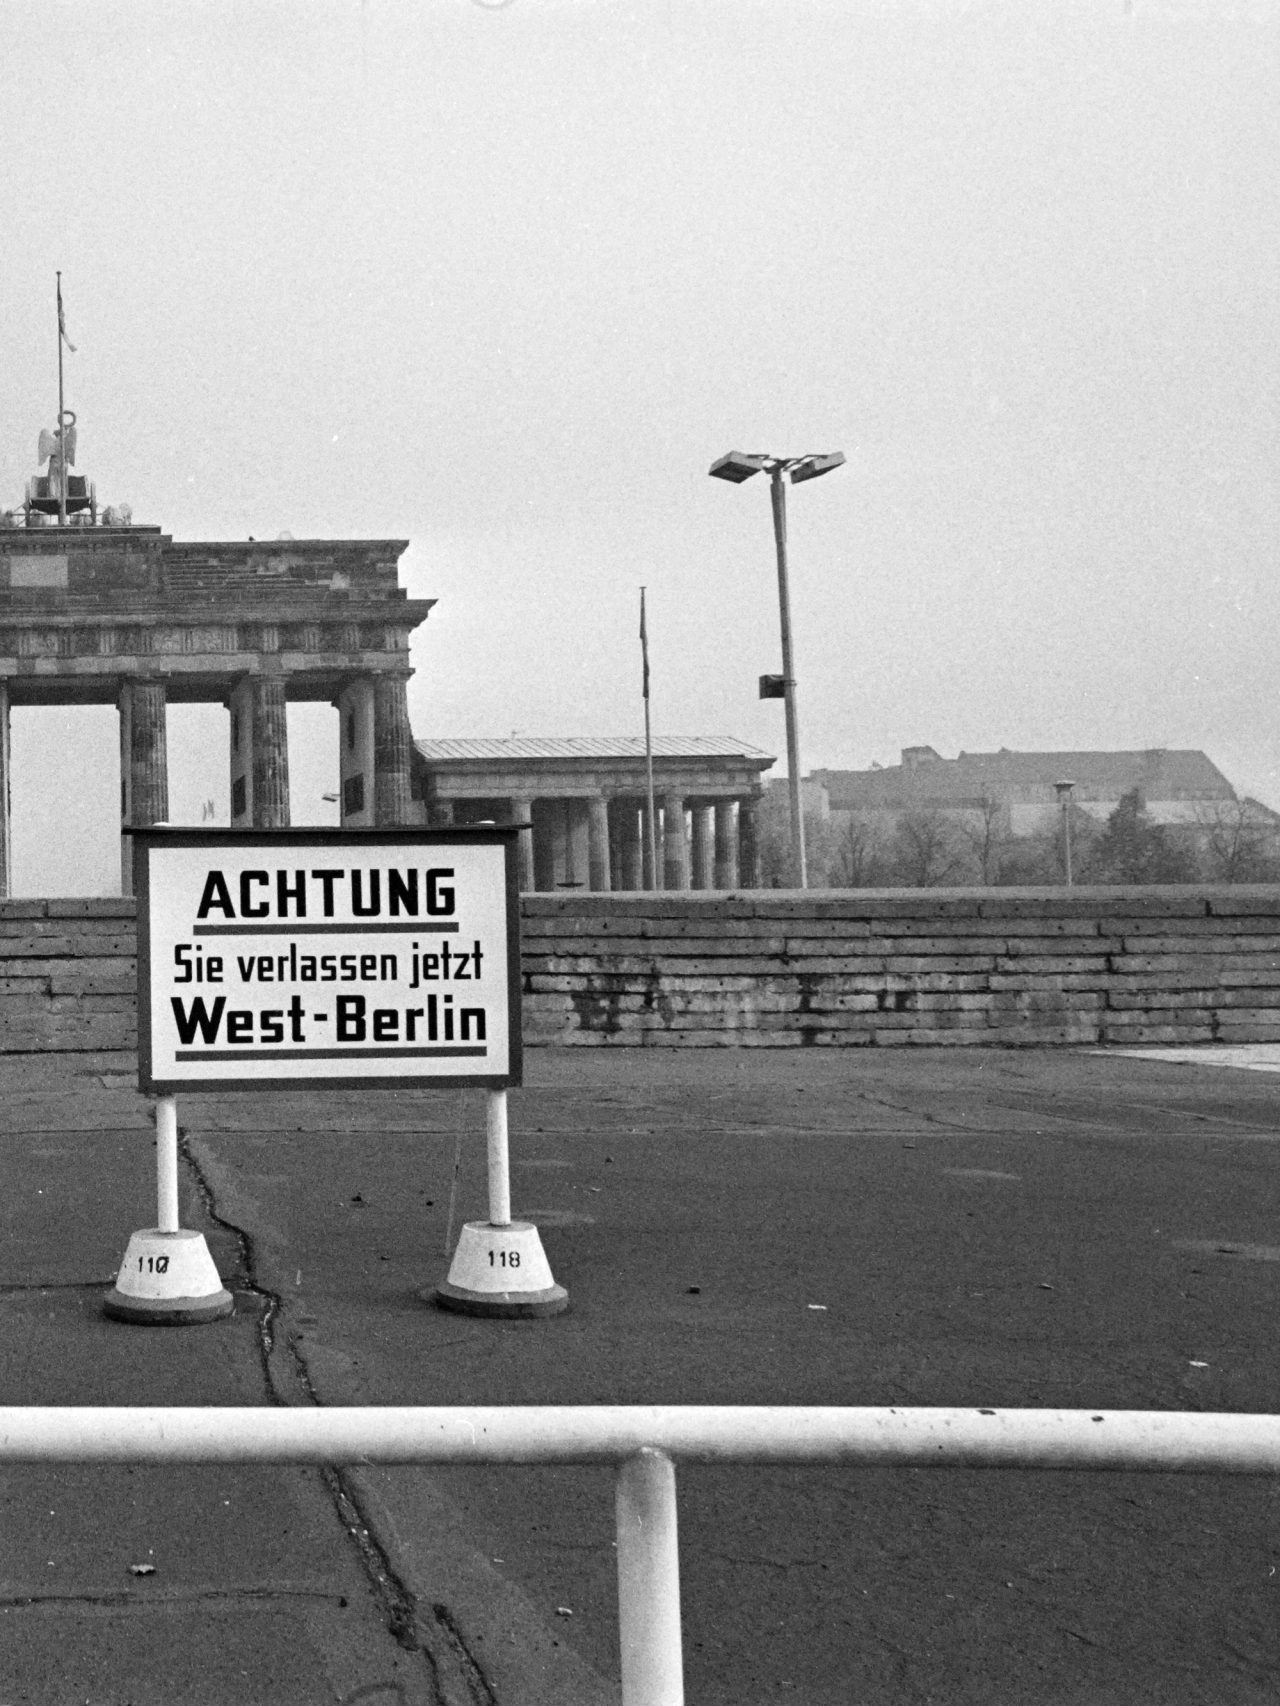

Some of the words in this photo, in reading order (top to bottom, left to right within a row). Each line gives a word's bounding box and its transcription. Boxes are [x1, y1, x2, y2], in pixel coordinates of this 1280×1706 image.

[196, 867, 456, 919] ACHTUNG
[173, 943, 224, 984] Sie
[236, 942, 398, 983] verlassen
[408, 940, 484, 989] jetzt
[170, 993, 487, 1045] West-Berlin
[488, 1250, 521, 1268] 118
